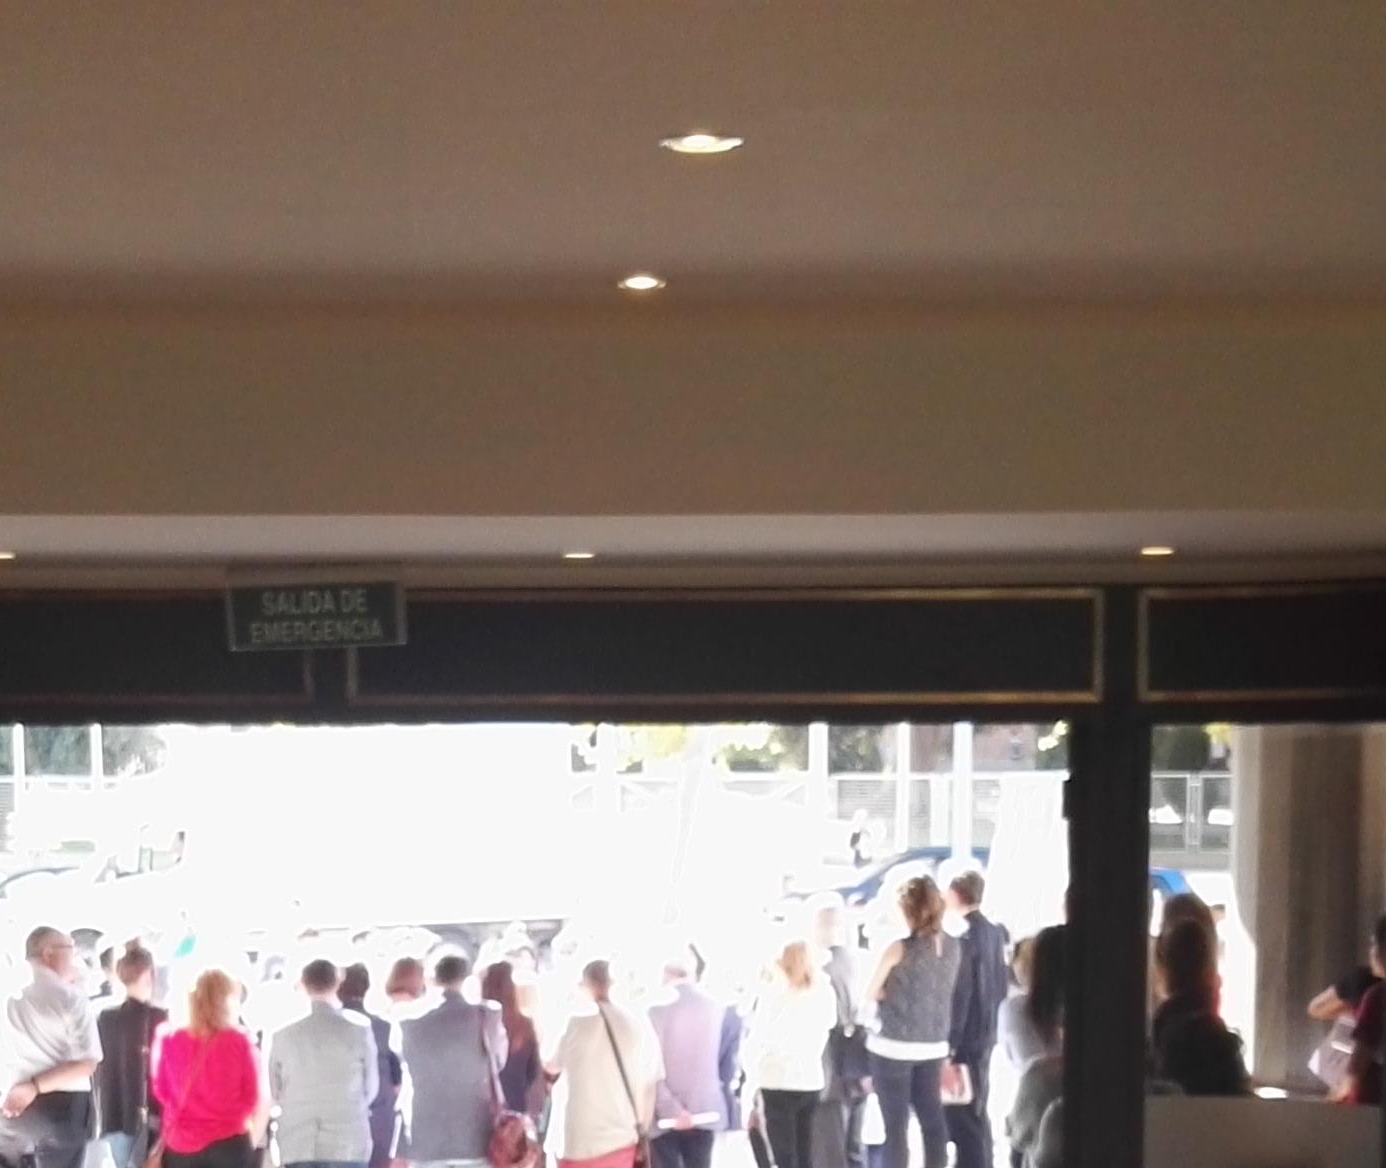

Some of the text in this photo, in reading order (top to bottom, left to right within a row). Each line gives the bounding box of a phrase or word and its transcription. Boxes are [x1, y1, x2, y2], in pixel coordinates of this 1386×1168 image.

[261, 588, 369, 616] SALIDA DE
[250, 618, 383, 644] EMERGENCIA
